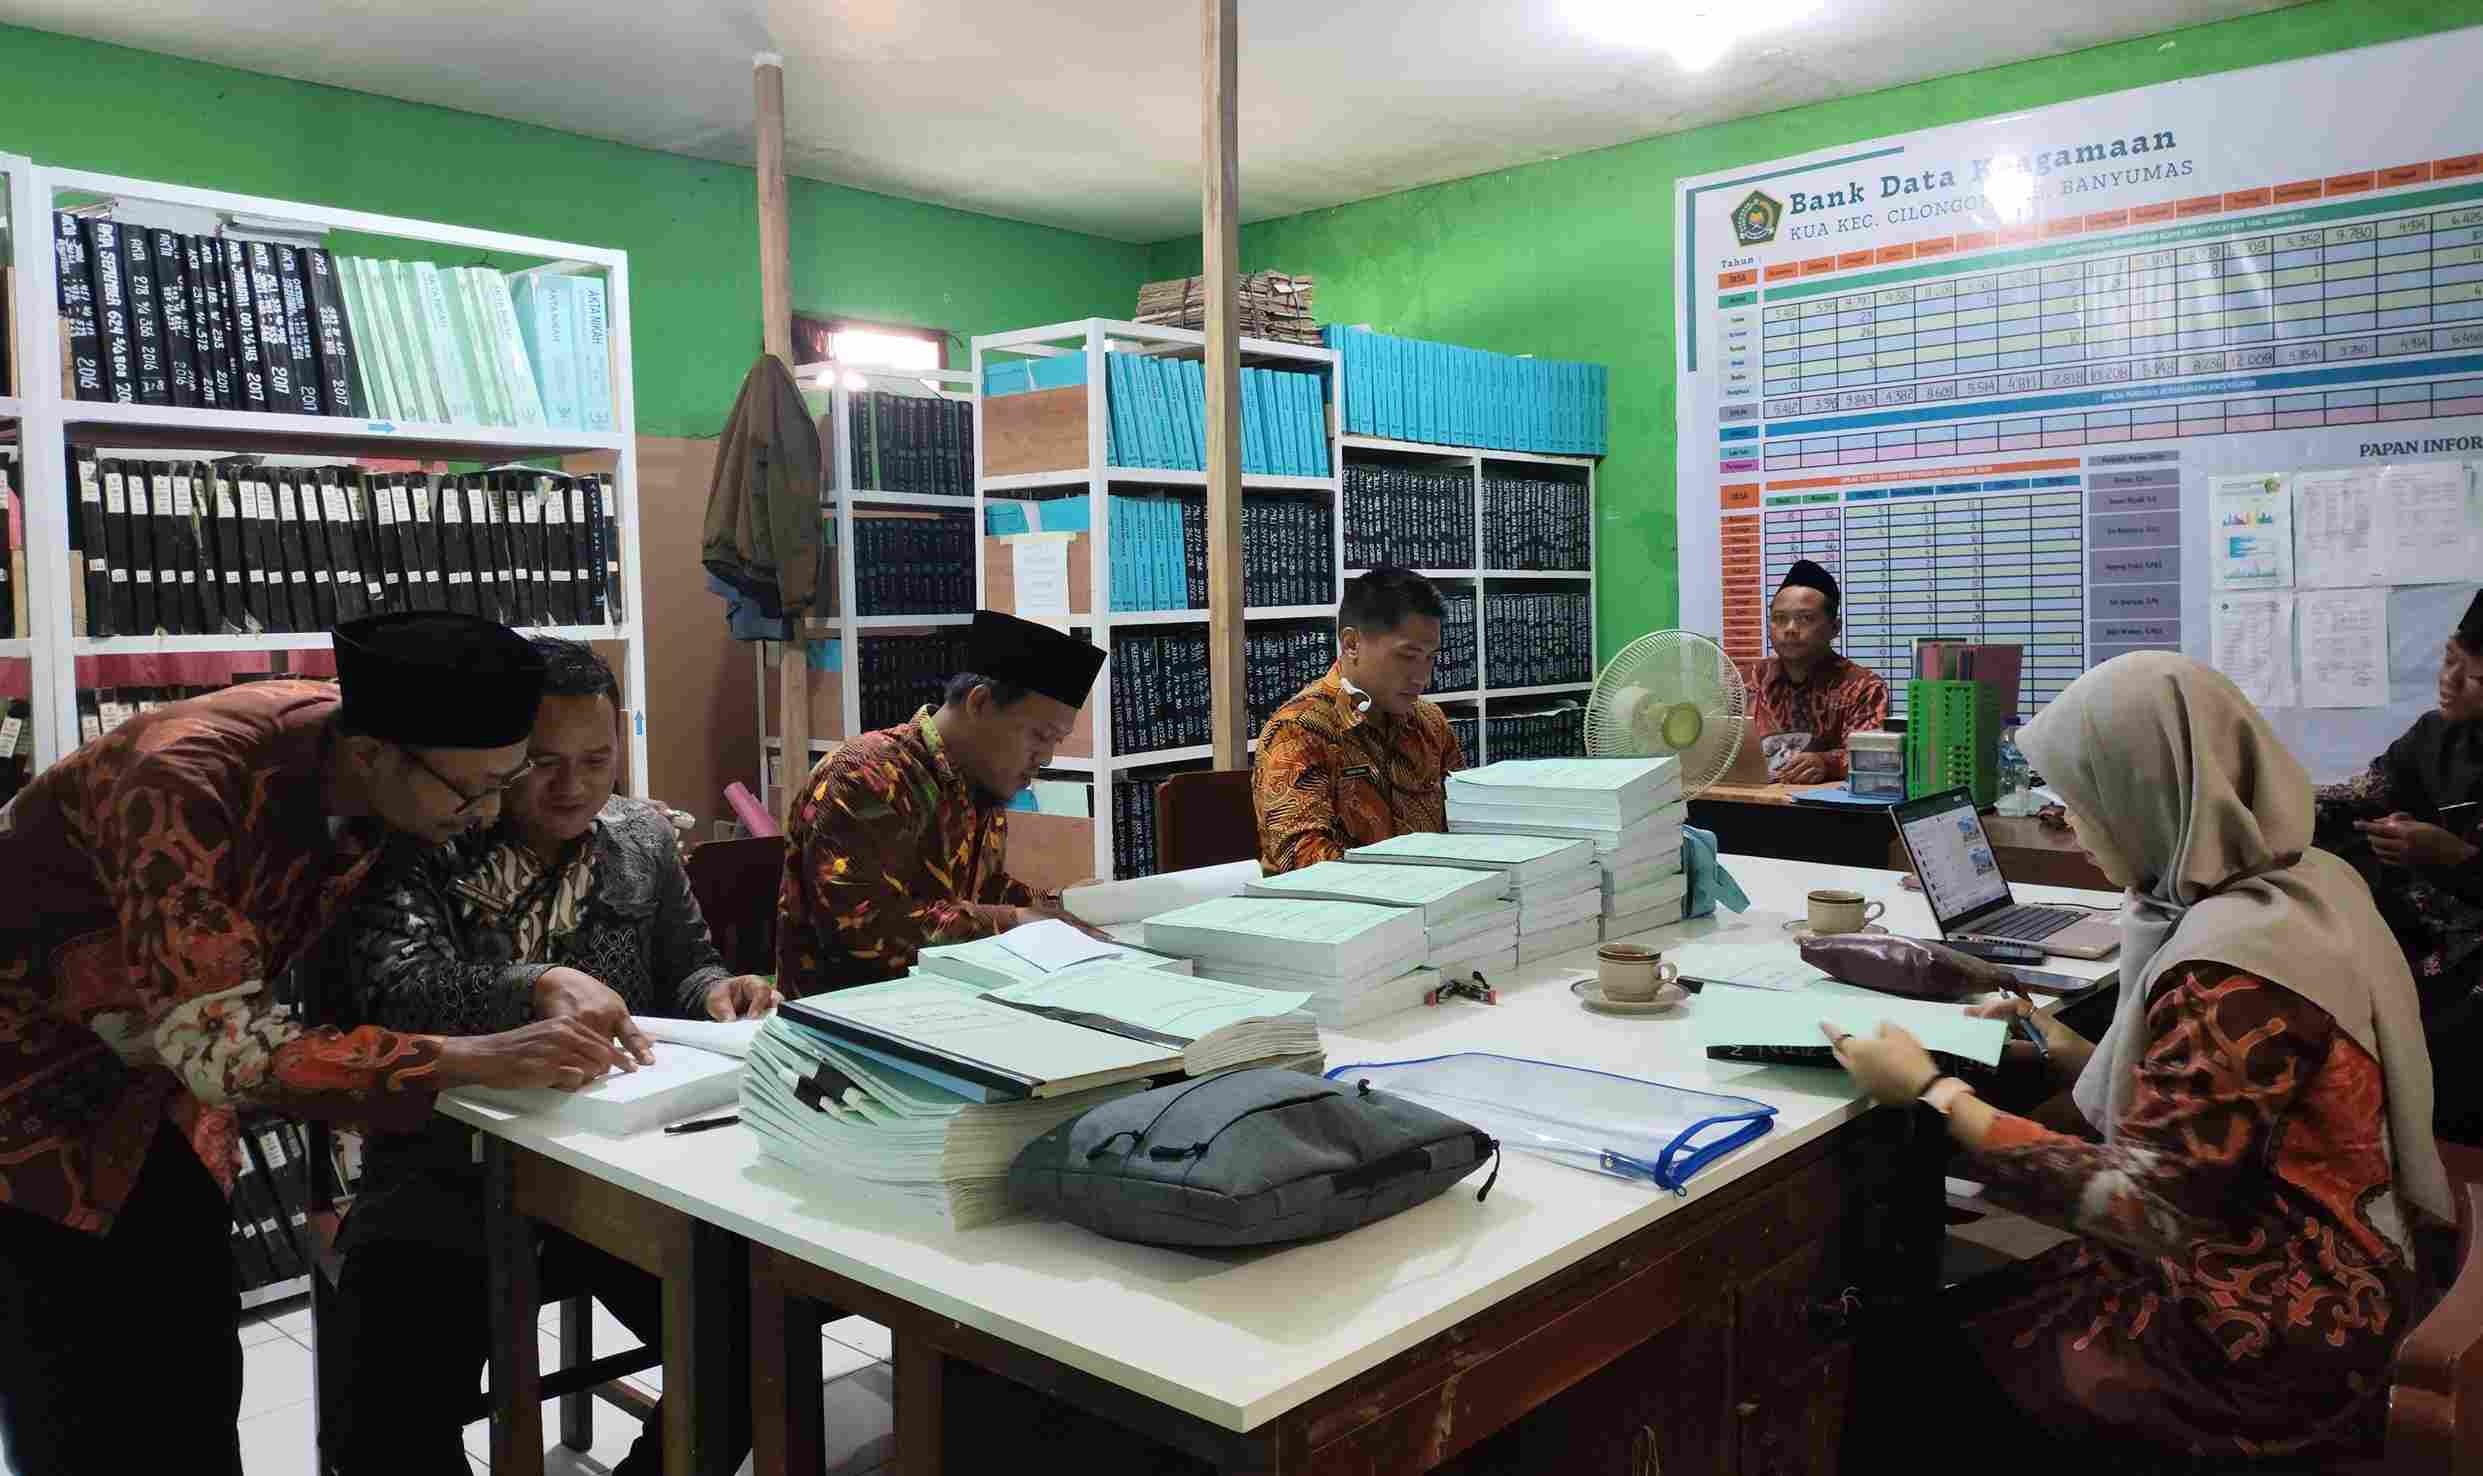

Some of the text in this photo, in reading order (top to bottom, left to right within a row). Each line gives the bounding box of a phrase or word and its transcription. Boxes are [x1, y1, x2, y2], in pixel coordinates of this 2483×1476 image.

[1789, 130, 2177, 215] Bank Data Kagamaan
[1790, 223, 1830, 242] KUA
[1837, 213, 1880, 235] KEC.
[1887, 193, 1991, 225] CILONGO
[2062, 159, 2193, 195] BANYUMAS
[159, 233, 173, 257] AKTA
[1721, 257, 1754, 269] Tahun
[97, 223, 114, 248] AKTA
[107, 310, 124, 335] 624
[130, 239, 145, 261] AKTA
[142, 346, 159, 371] 2016
[587, 288, 601, 316] AKTA
[77, 356, 99, 389] 2016
[247, 372, 265, 401] 2017
[272, 366, 290, 394] 2017
[332, 379, 348, 406] 2017
[2360, 440, 2419, 457] PAPAN
